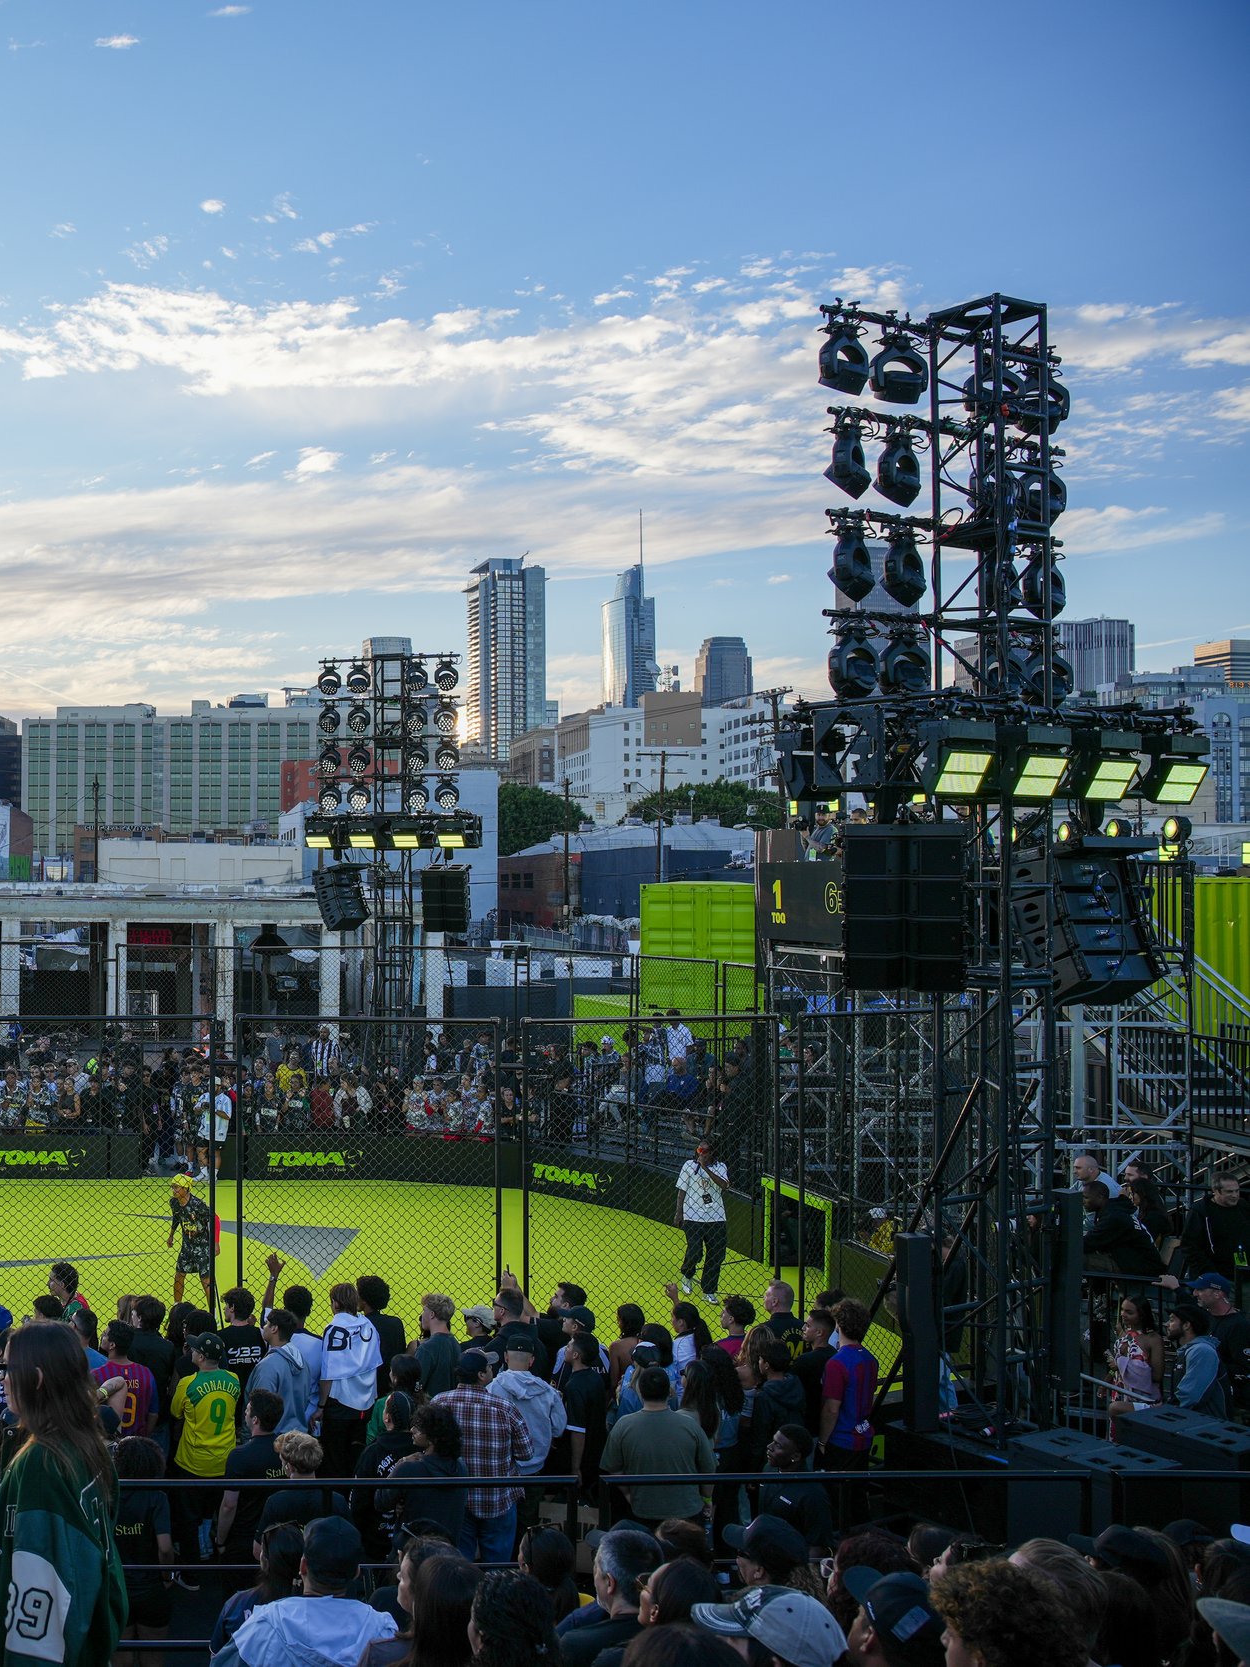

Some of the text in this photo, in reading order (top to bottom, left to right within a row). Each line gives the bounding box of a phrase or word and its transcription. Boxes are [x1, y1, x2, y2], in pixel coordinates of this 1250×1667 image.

[772, 880, 782, 910] 1
[267, 1151, 346, 1167] TOMA
[532, 1162, 597, 1190] TOMA
[227, 1346, 261, 1357] 433
[196, 1379, 240, 1397] RONALDO
[211, 1398, 227, 1436] 9
[114, 1522, 144, 1537] Staff
